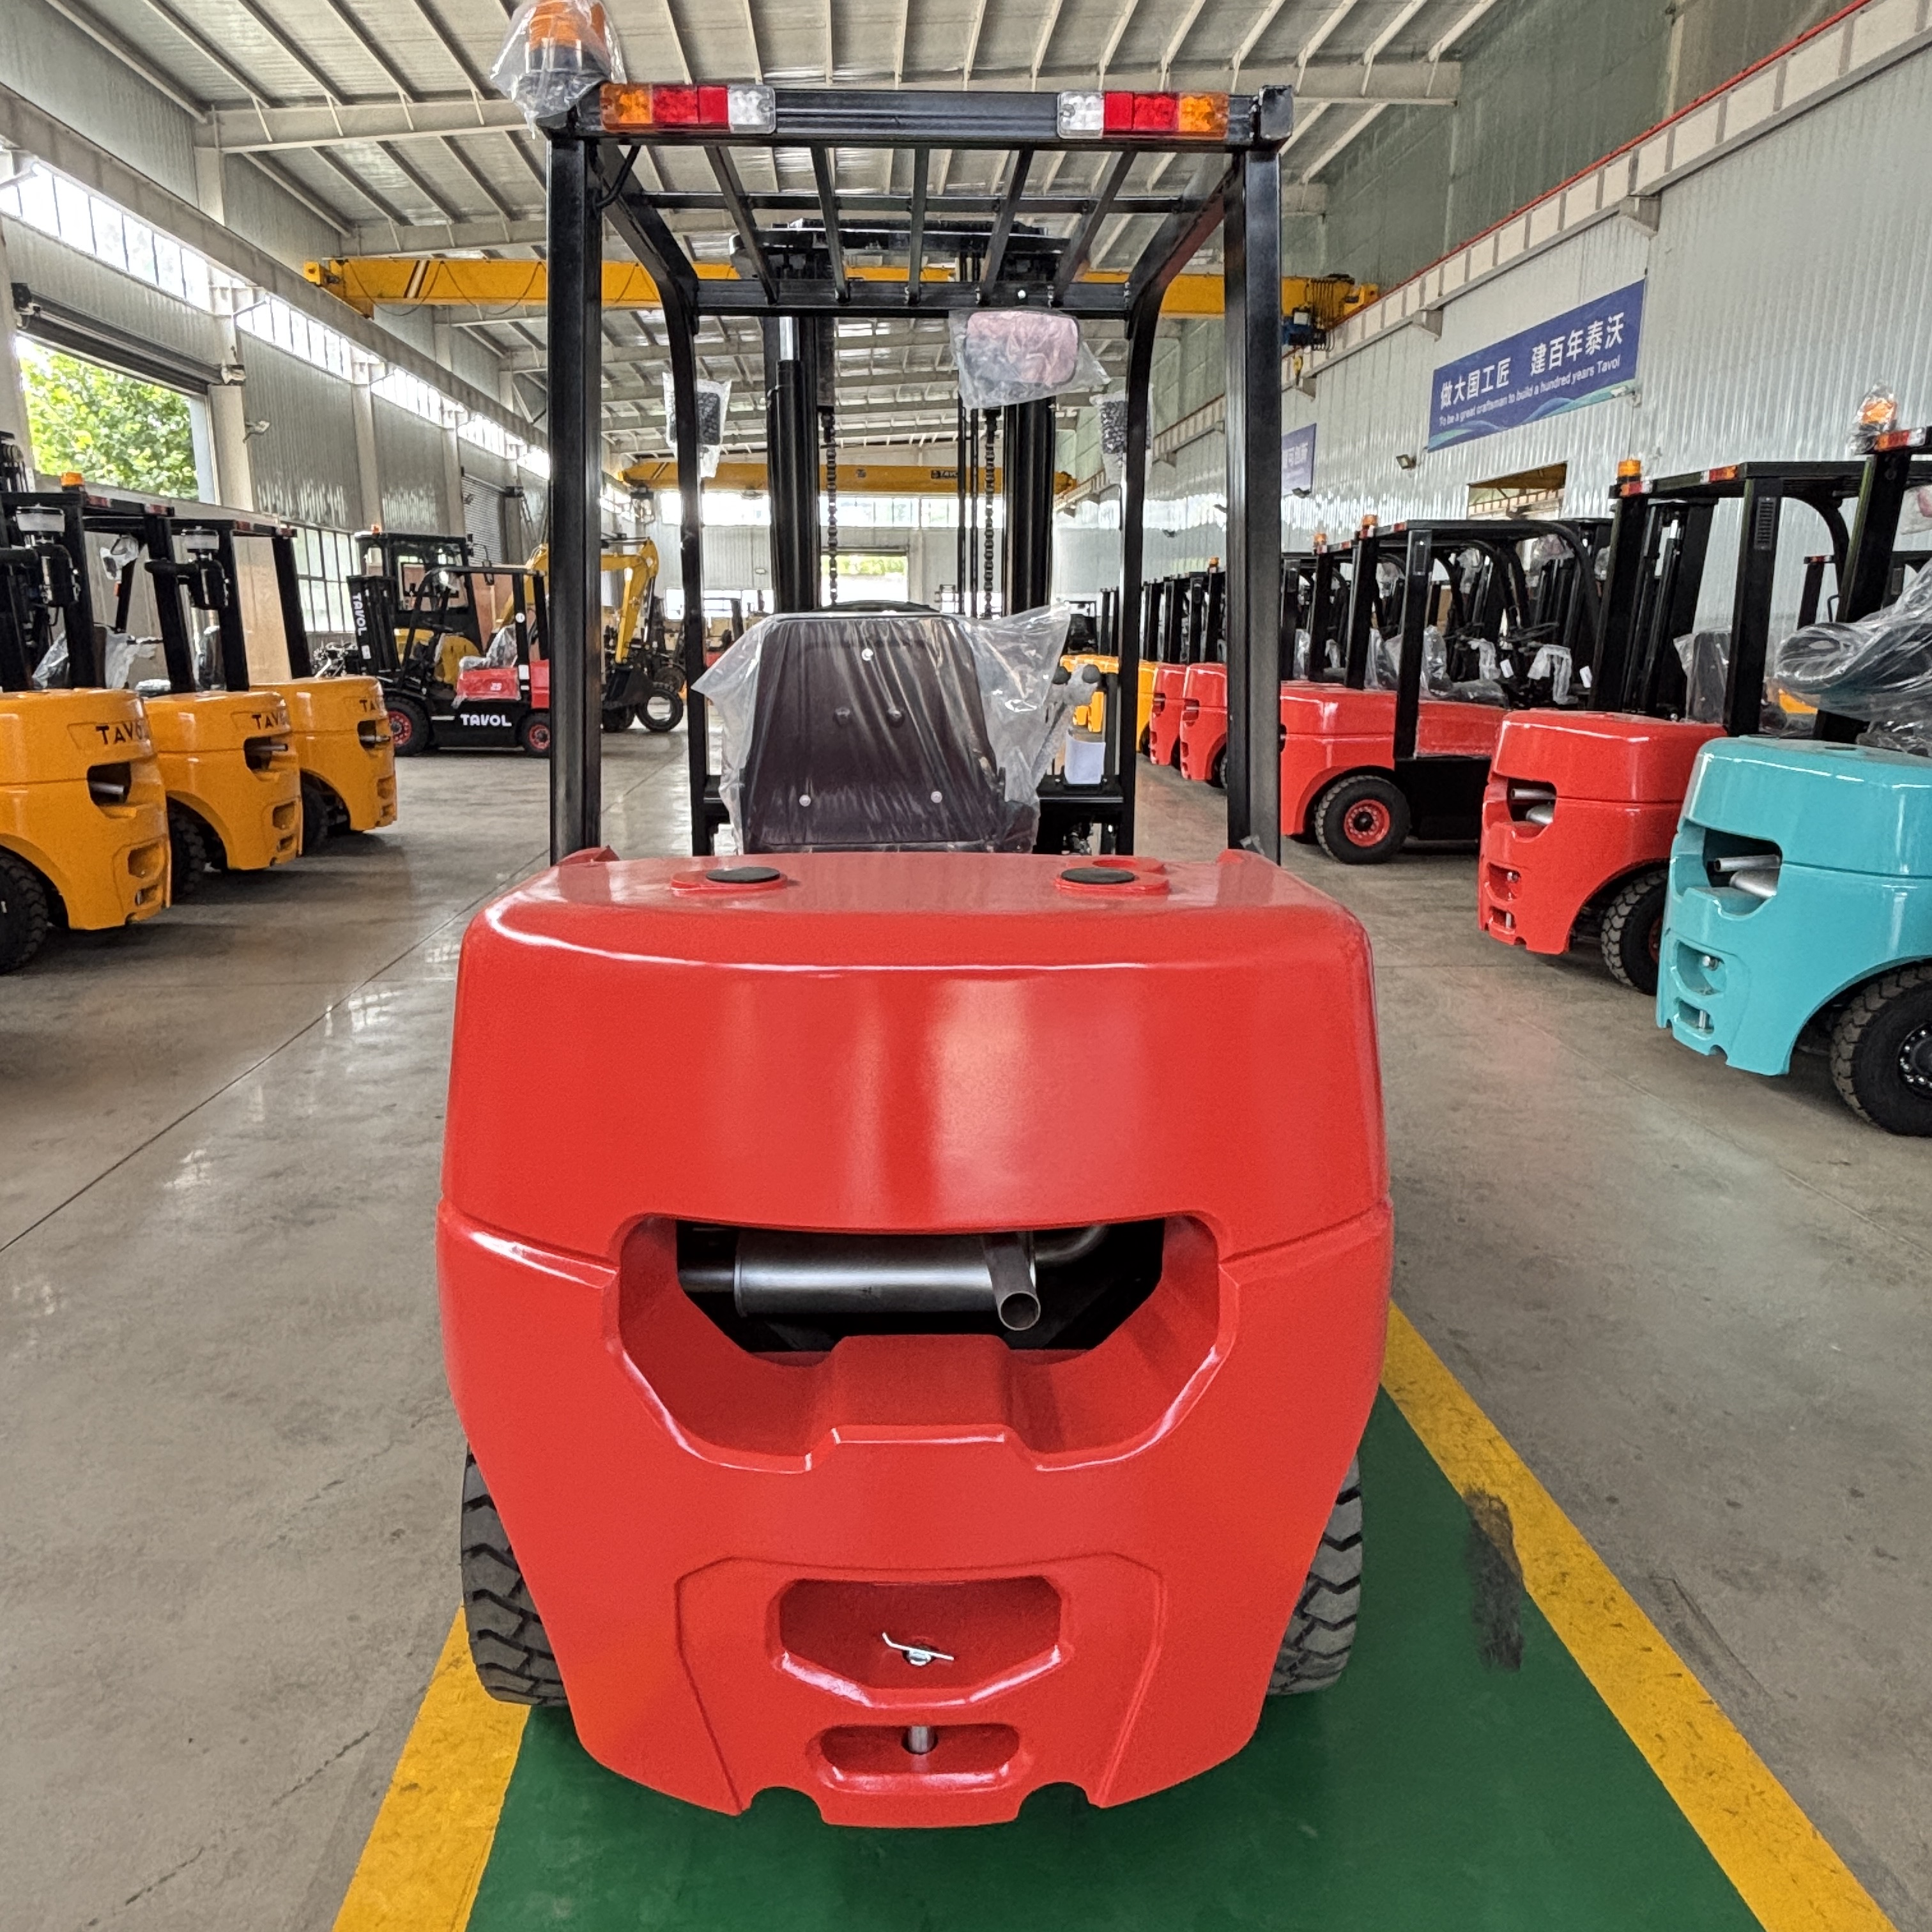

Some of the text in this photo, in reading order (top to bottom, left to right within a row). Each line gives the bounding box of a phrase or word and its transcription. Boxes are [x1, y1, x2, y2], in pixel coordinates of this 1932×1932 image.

[1441, 312, 1624, 410] 做大国工匠 建百年泰沃
[1516, 385, 1533, 401] build
[1540, 372, 1571, 393] hundred
[1571, 366, 1595, 385] years
[1597, 354, 1621, 374] Tavol
[352, 592, 367, 636] TAVOL
[460, 714, 512, 726] TAVOL
